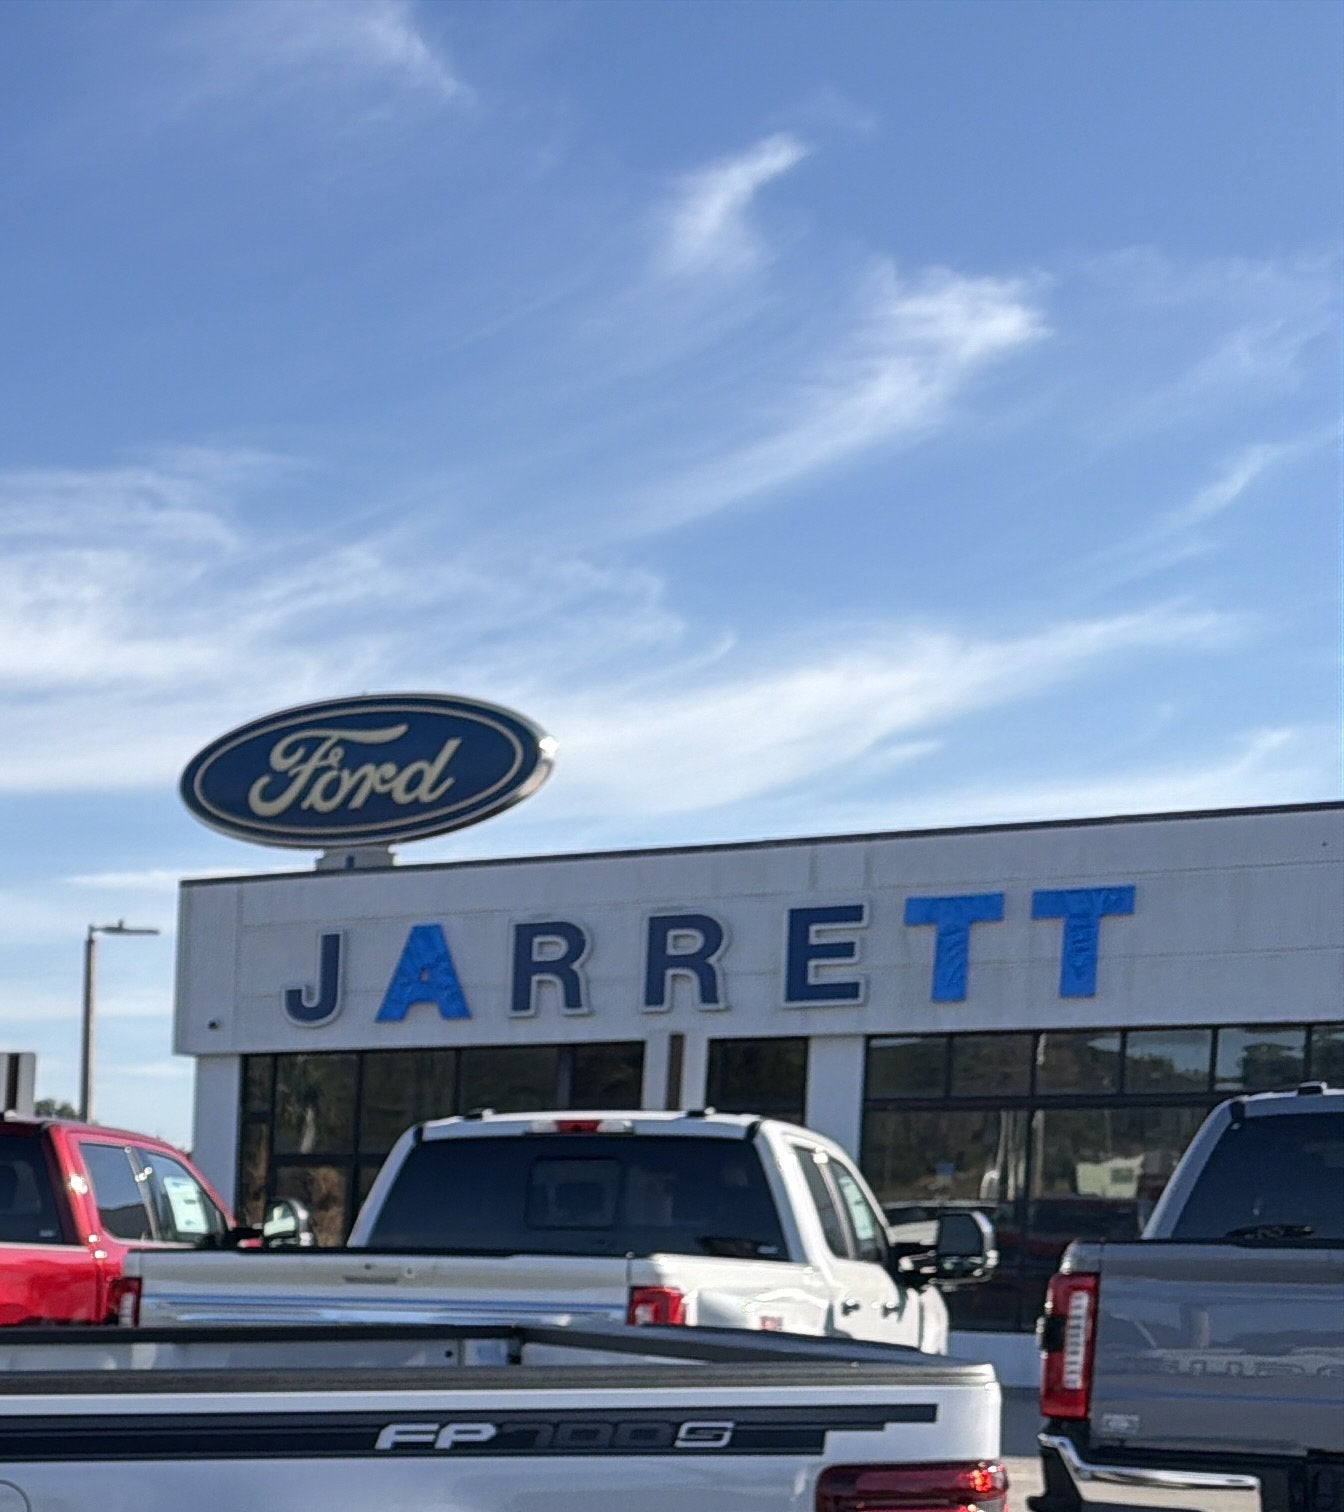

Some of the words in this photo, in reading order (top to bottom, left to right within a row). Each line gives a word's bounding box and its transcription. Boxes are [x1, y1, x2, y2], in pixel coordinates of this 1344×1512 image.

[248, 704, 462, 818] Ford
[282, 885, 1136, 1026] JARRETT
[374, 1421, 735, 1450] FP700S
